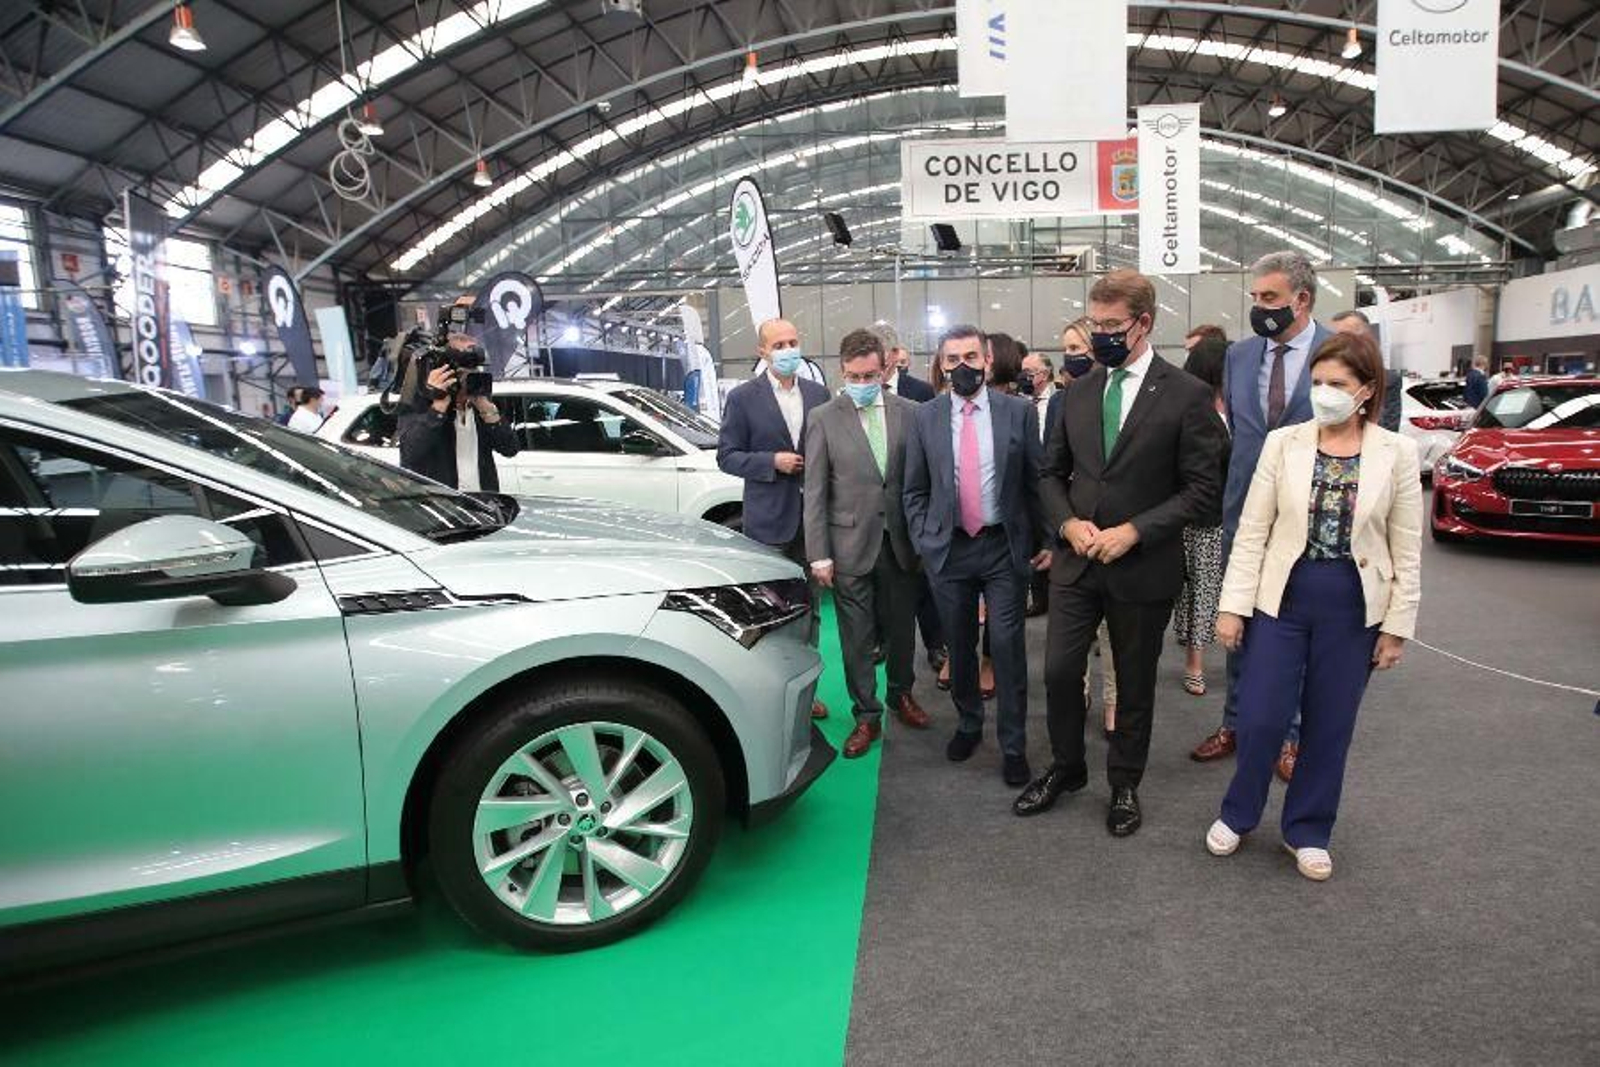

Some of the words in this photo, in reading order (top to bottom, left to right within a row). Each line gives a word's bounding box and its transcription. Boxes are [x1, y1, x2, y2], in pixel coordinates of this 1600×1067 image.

[1389, 29, 1490, 46] Celtamotor
[924, 151, 1078, 177] CONCELLO
[944, 183, 980, 204] DE
[992, 180, 1061, 202] VIGO
[1162, 146, 1178, 268] Celtamotor
